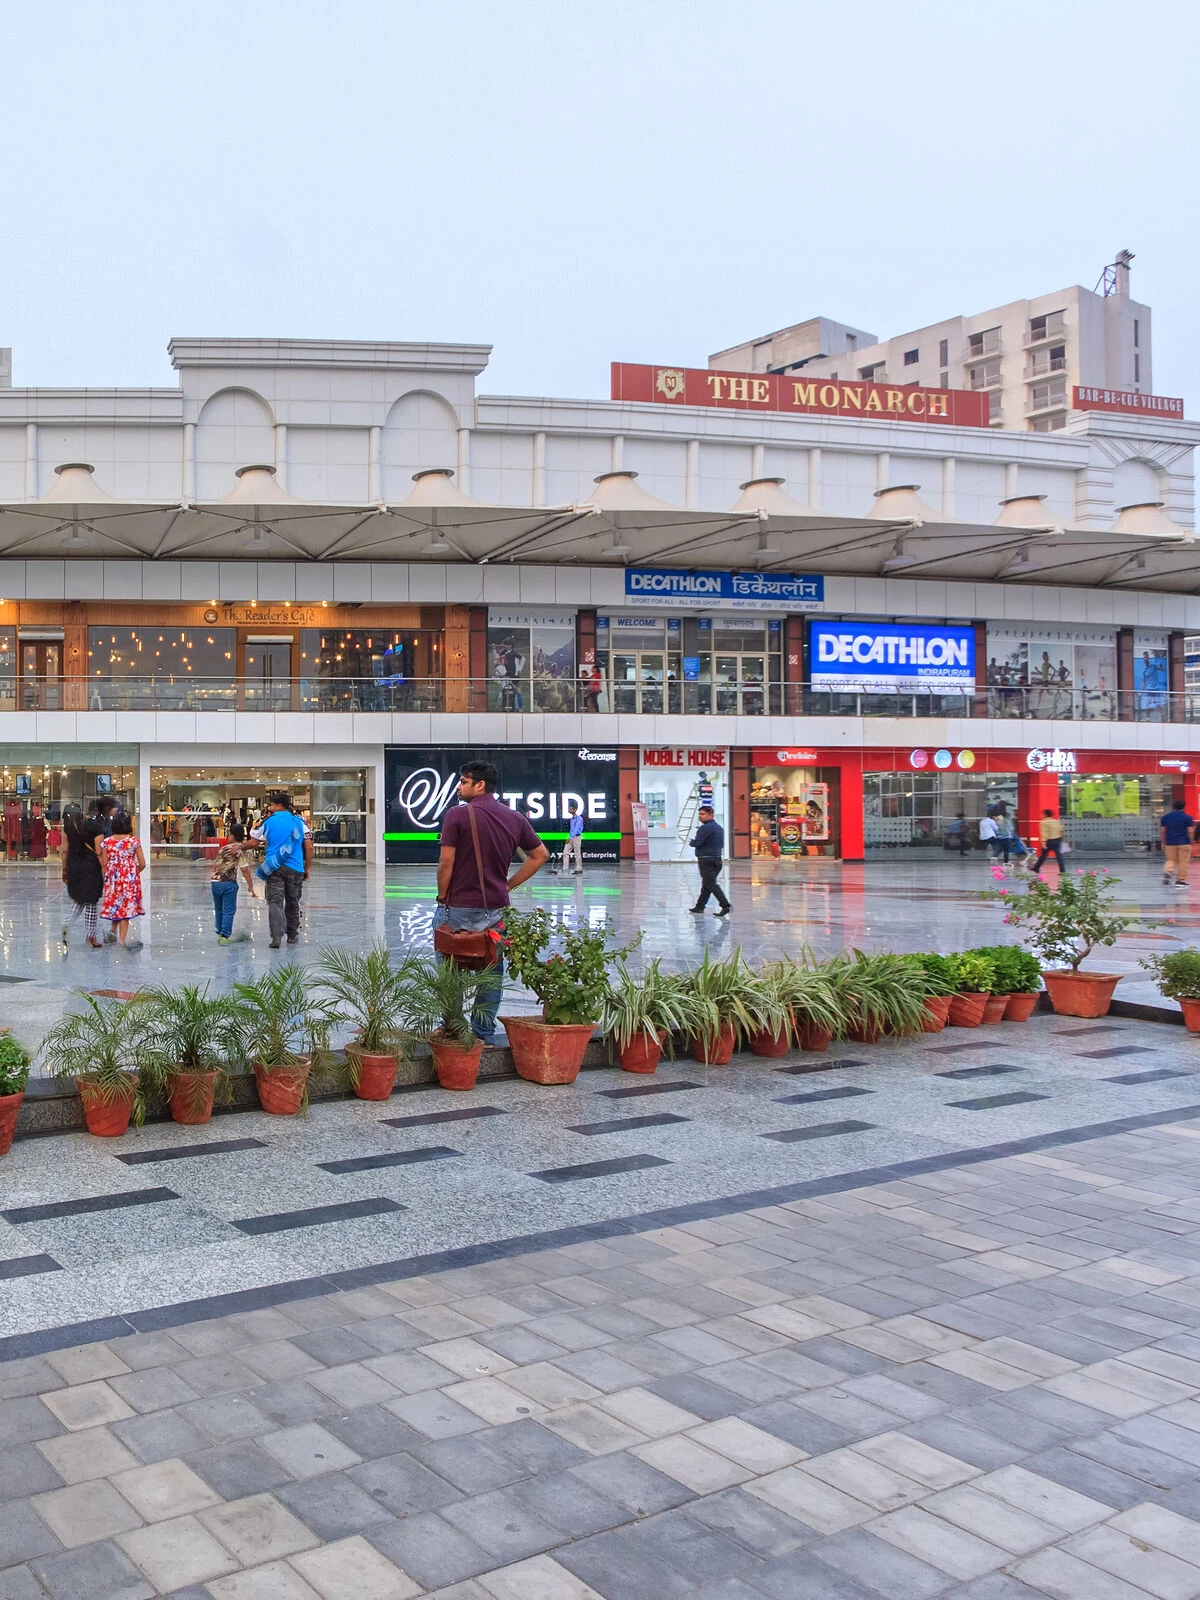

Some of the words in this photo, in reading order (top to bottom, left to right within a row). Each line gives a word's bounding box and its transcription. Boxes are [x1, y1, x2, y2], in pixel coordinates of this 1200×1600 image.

[708, 375, 770, 403] THE
[793, 383, 949, 417] MONARCH
[1079, 388, 1139, 407] BAR-BE-CUE
[1141, 396, 1182, 412] VILLAGE
[631, 574, 721, 592] DECATHLON
[732, 574, 818, 596] डिकैथलॉन
[222, 609, 241, 620] The
[245, 609, 288, 621] Reader's
[291, 609, 315, 625] Café
[617, 618, 657, 627] WELCOME
[818, 634, 968, 666] DECATHLON
[917, 668, 970, 677] INDIRAPURAM
[643, 750, 684, 766] MOBILE
[688, 750, 726, 766] HOUSE
[399, 767, 608, 829] WTSIDE
[582, 851, 617, 859] Enterprise
